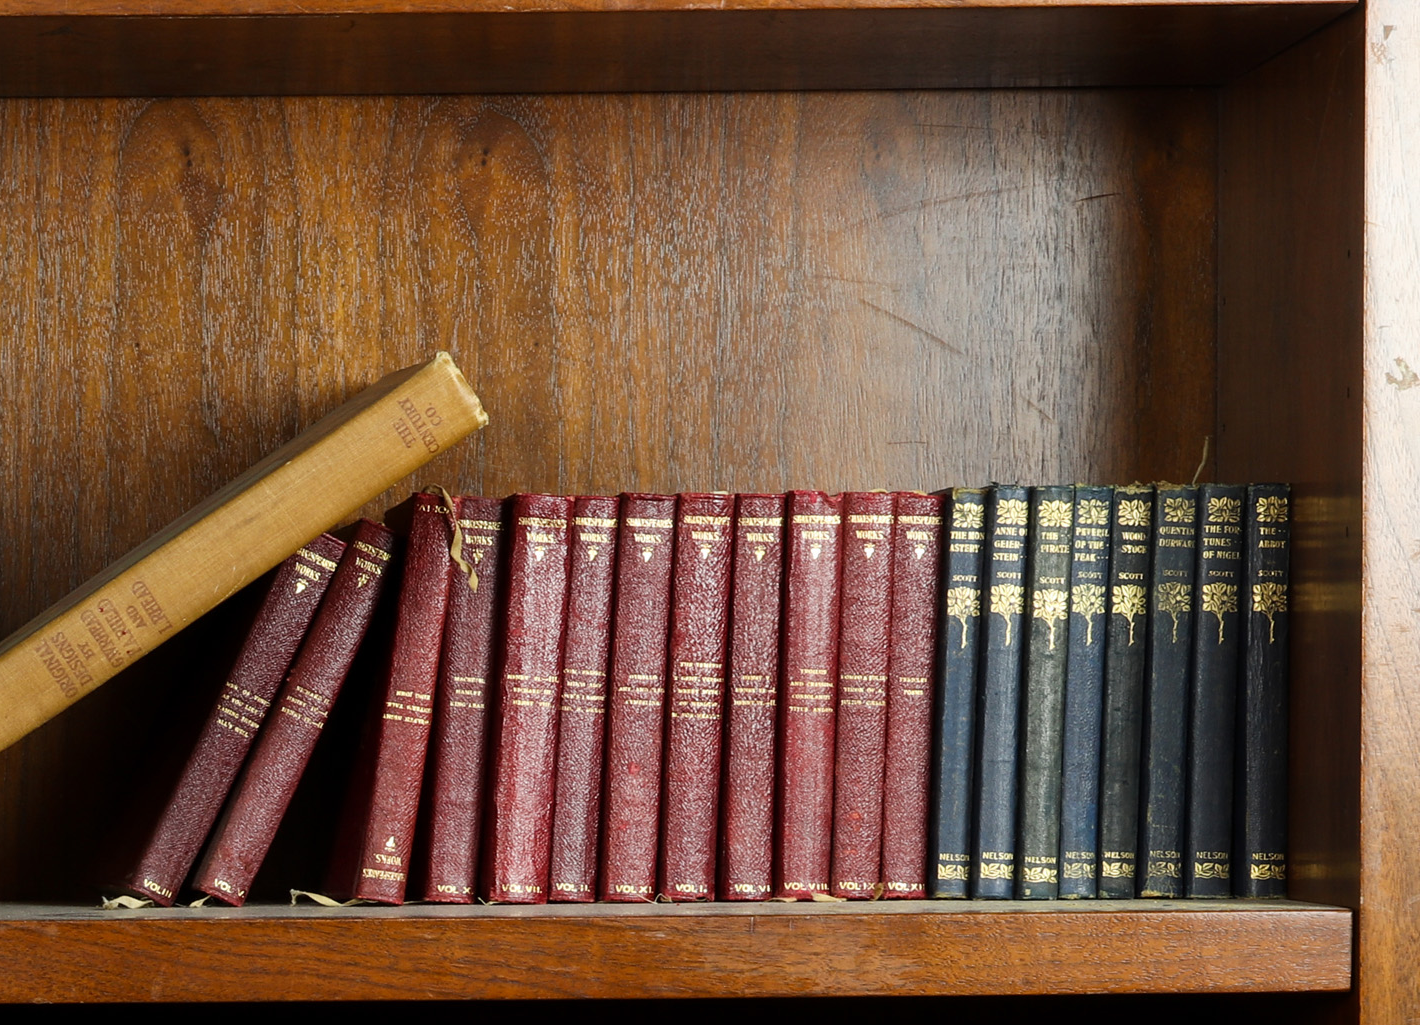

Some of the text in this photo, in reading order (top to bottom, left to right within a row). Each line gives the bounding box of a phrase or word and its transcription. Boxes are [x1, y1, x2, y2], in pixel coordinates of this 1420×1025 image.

[425, 402, 442, 426] CO.
[397, 397, 440, 454] CENTURY
[393, 417, 416, 448] THE
[994, 526, 1018, 536] ANNE
[1076, 527, 1109, 537] PEVERIL
[1160, 526, 1195, 535] QUENTIN
[1204, 525, 1221, 533] THE
[1259, 526, 1276, 535] THE
[950, 531, 967, 540] THE
[1041, 532, 1058, 540] THE
[1122, 531, 1146, 541] WOOD
[994, 540, 1024, 549] GEIER-
[1075, 540, 1104, 550] OF THE
[1203, 537, 1232, 547] TUNES
[1258, 540, 1286, 549] ABBOT
[1041, 544, 1070, 553] PIRATE
[1121, 545, 1147, 554] STOCK
[993, 552, 1019, 561] STEIN
[1074, 553, 1097, 562] PEAK
[1203, 551, 1241, 560] OF NIGEL
[996, 571, 1022, 579] SCOTT
[1077, 571, 1102, 579] SCOTT
[1118, 572, 1144, 580] SCOTT
[1163, 569, 1188, 577] SCOTT
[1208, 570, 1234, 578] SCOTT
[1258, 569, 1284, 577] SCOTT
[953, 574, 978, 582] SCOTT
[1040, 576, 1066, 584] SCOTT
[126, 605, 147, 629] AND
[77, 641, 94, 660] BY
[51, 632, 93, 686] DESIGNS
[35, 638, 78, 699] ORIGINAL
[939, 853, 970, 862] NELSON
[982, 852, 1013, 861] NELSON
[1065, 851, 1095, 860] NELSON
[1104, 851, 1134, 860] NELSON
[1149, 850, 1180, 859] NELSON
[1196, 851, 1228, 860] NELSON
[1252, 852, 1284, 861] NELSON
[1024, 856, 1056, 865] NELSON
[144, 878, 162, 895] VOL
[214, 878, 233, 893] VOL
[437, 884, 459, 894] VOL
[502, 884, 523, 893] VOL
[556, 882, 577, 892] VOL
[615, 884, 636, 893] VOL
[675, 883, 697, 893] VOL
[735, 884, 756, 893] VOL
[784, 882, 806, 891] VOL
[839, 882, 861, 891] VOL
[888, 882, 909, 891] VOL
